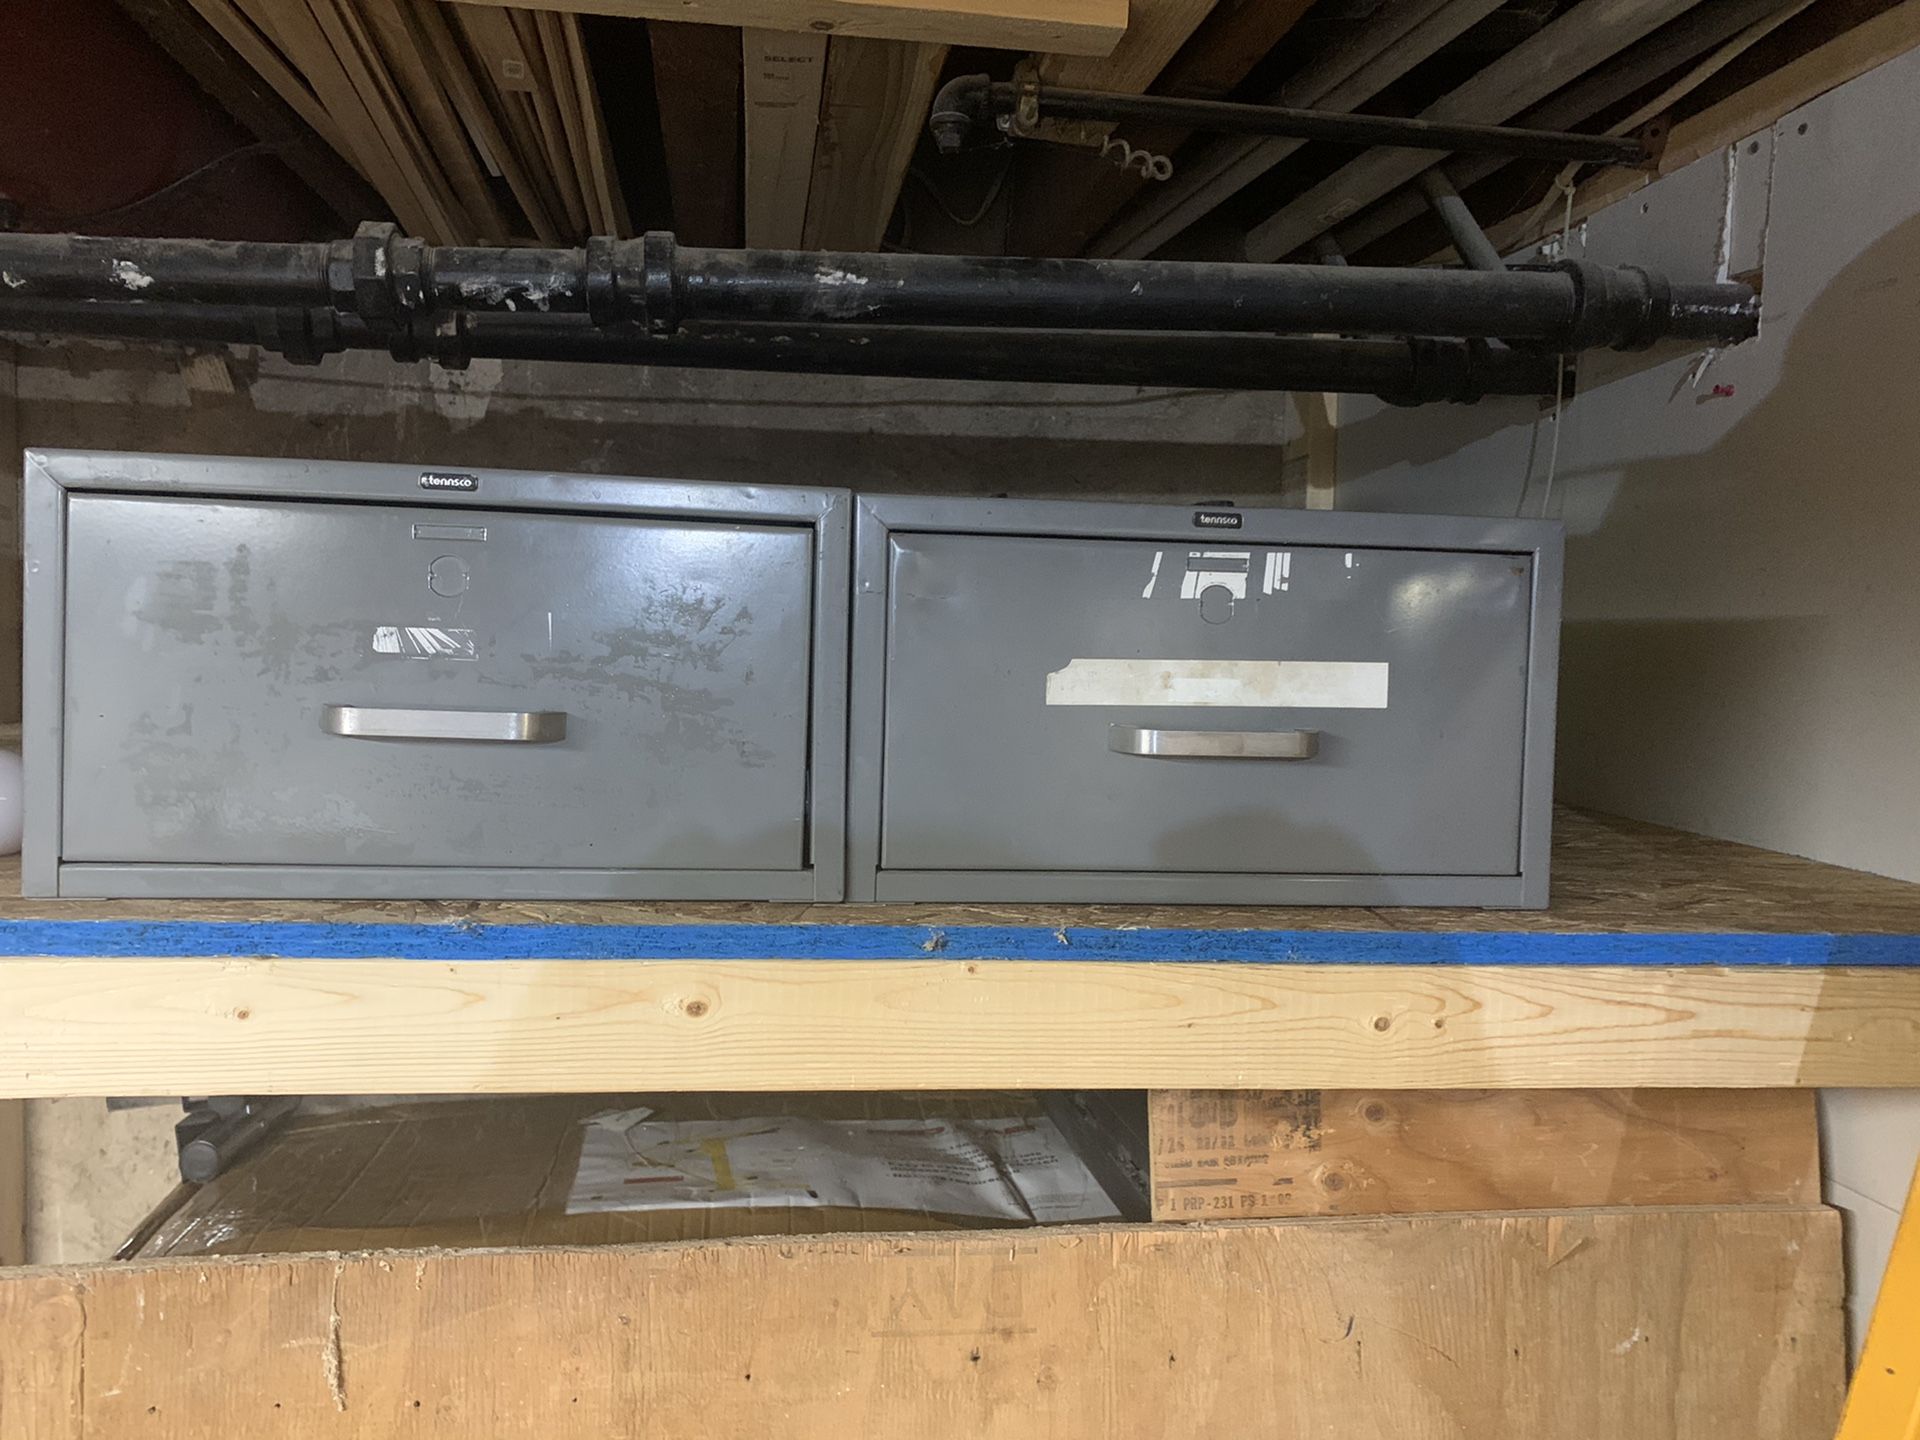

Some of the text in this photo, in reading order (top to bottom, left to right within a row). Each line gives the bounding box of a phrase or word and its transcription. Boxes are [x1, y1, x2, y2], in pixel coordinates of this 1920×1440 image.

[763, 55, 814, 63] SELECT
[428, 475, 472, 487] tennsco
[1200, 514, 1238, 525] tennsco
[1183, 1195, 1235, 1211] PRP-231
[1239, 1194, 1256, 1209] PS
